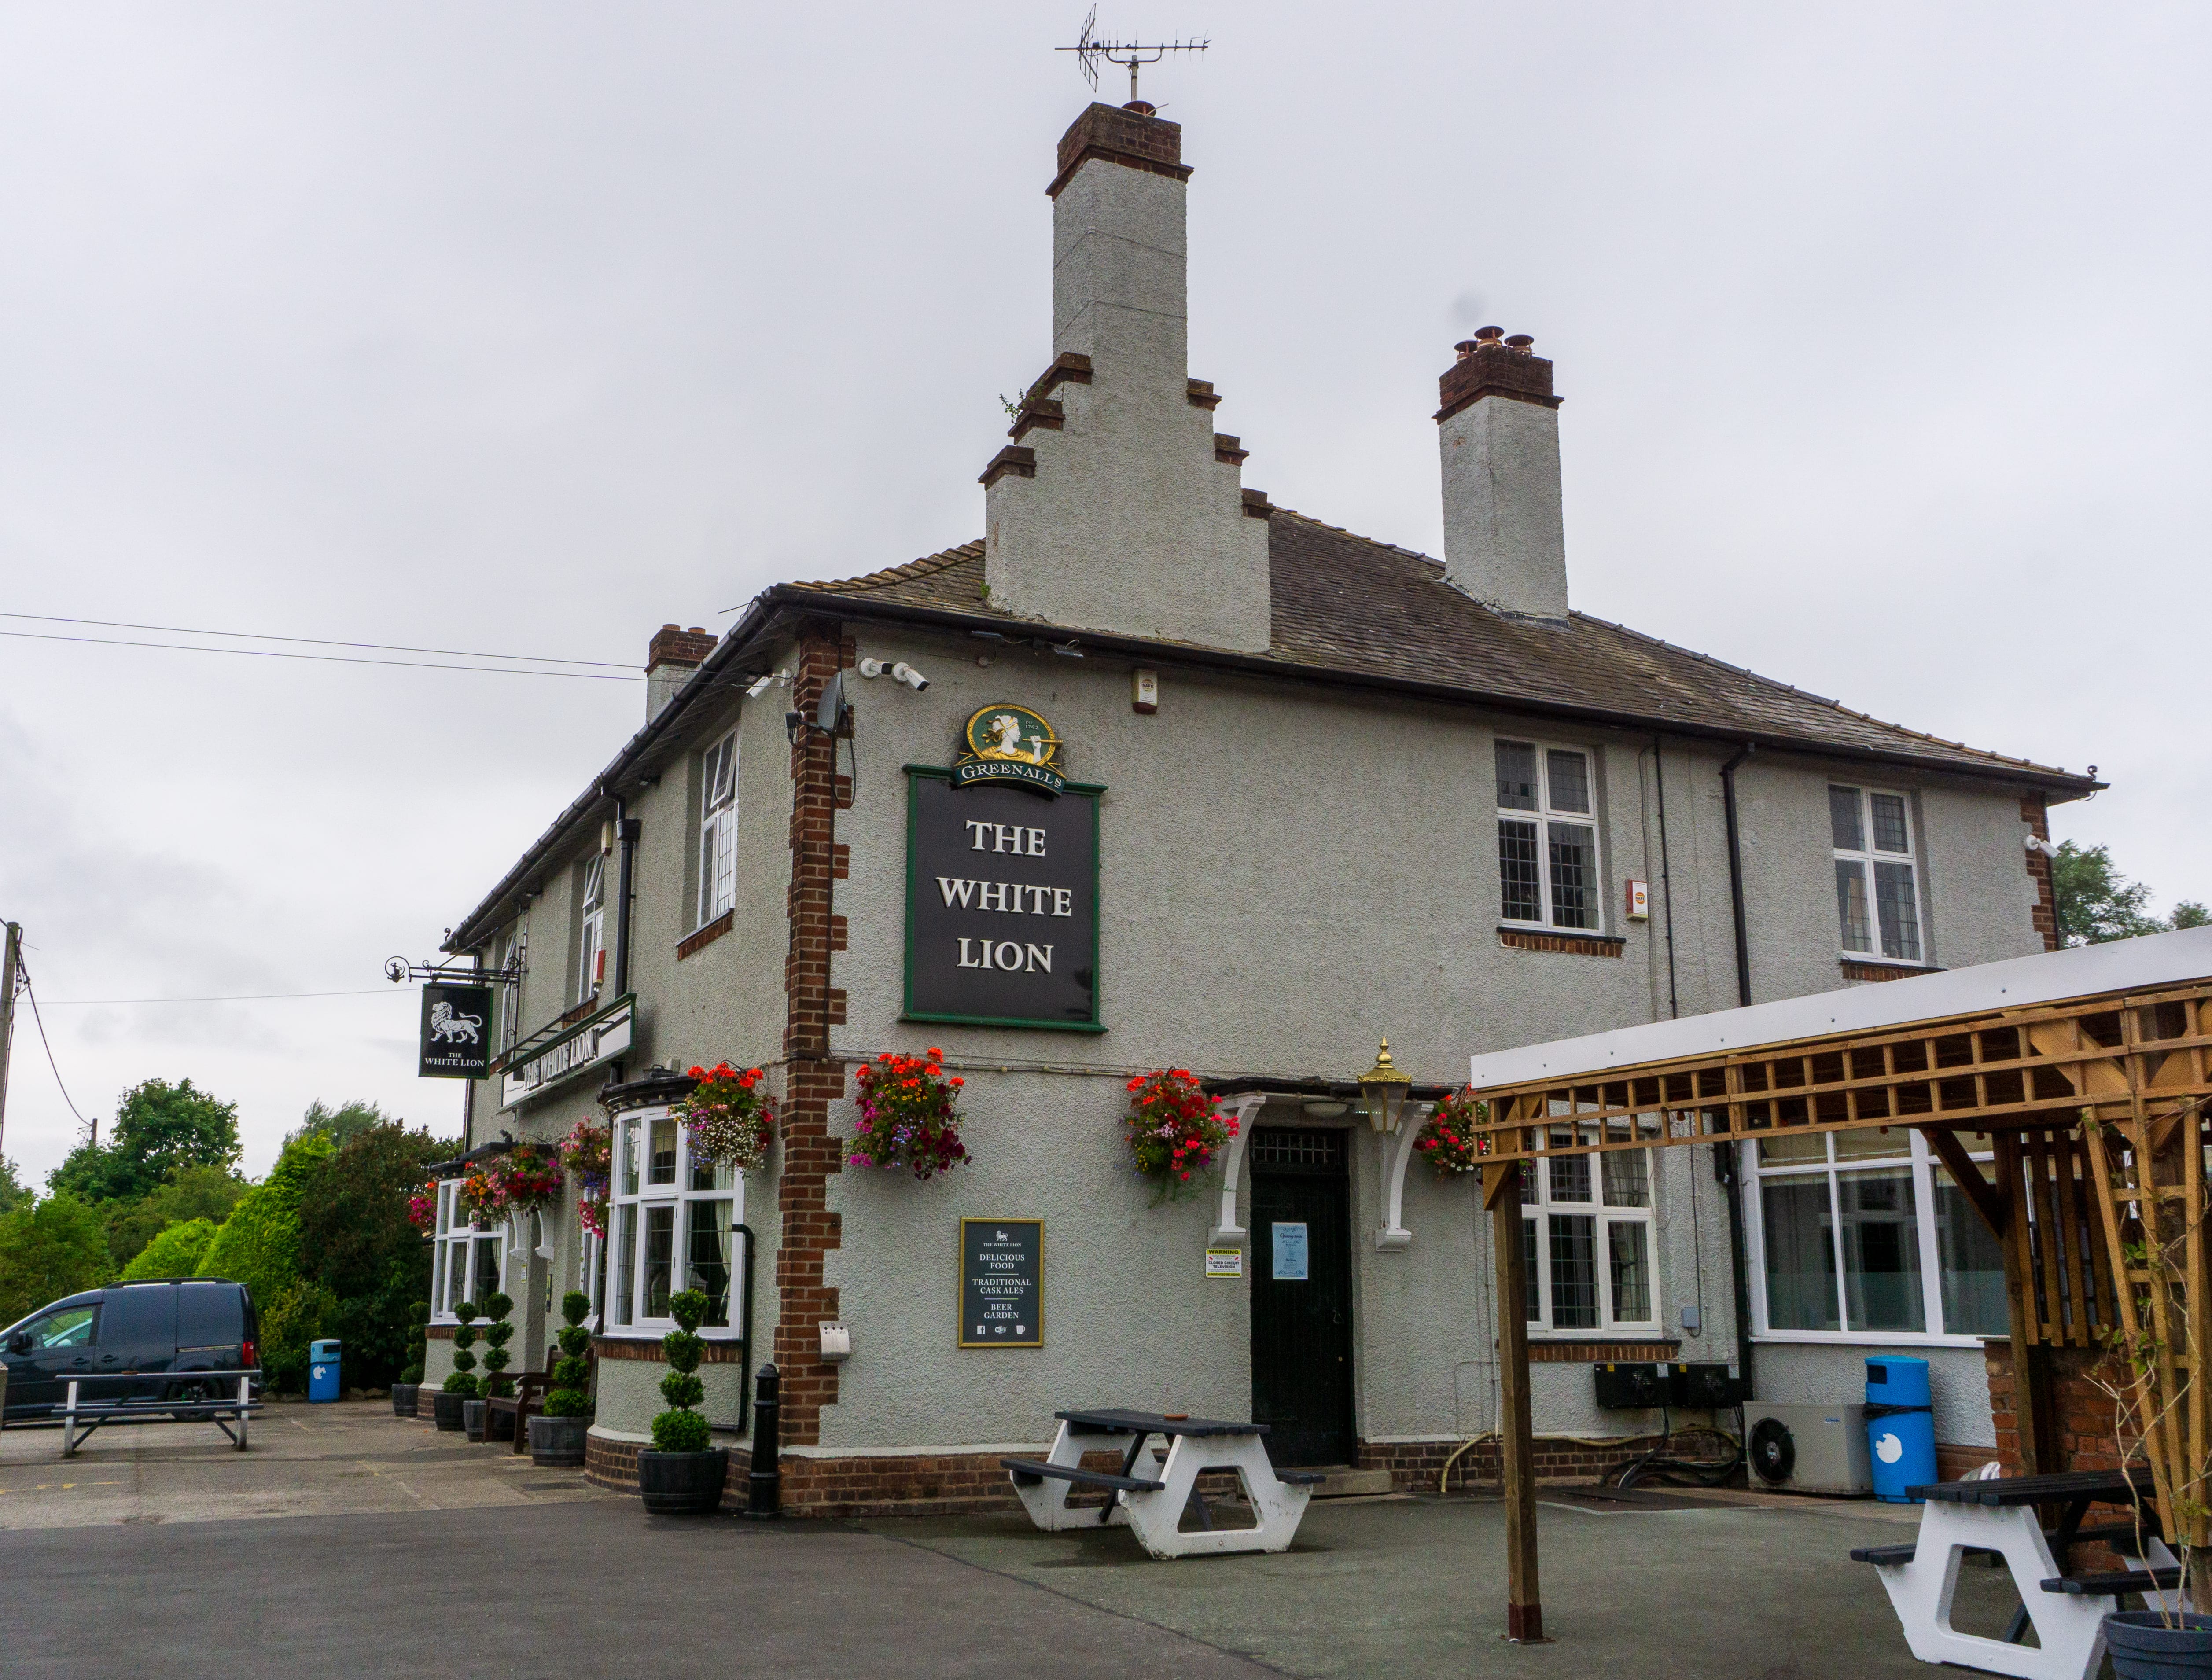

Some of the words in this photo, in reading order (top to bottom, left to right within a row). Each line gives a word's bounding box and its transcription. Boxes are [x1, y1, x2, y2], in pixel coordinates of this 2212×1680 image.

[961, 764, 1062, 788] GREENALLS
[965, 819, 1046, 857] THE
[936, 877, 1072, 917] WHITE
[956, 937, 1054, 974] LION
[425, 1057, 459, 1066] WHITE
[460, 1059, 485, 1067] LION
[523, 1058, 541, 1091] THE
[540, 1041, 570, 1082] WHITE
[570, 1028, 600, 1068] LION
